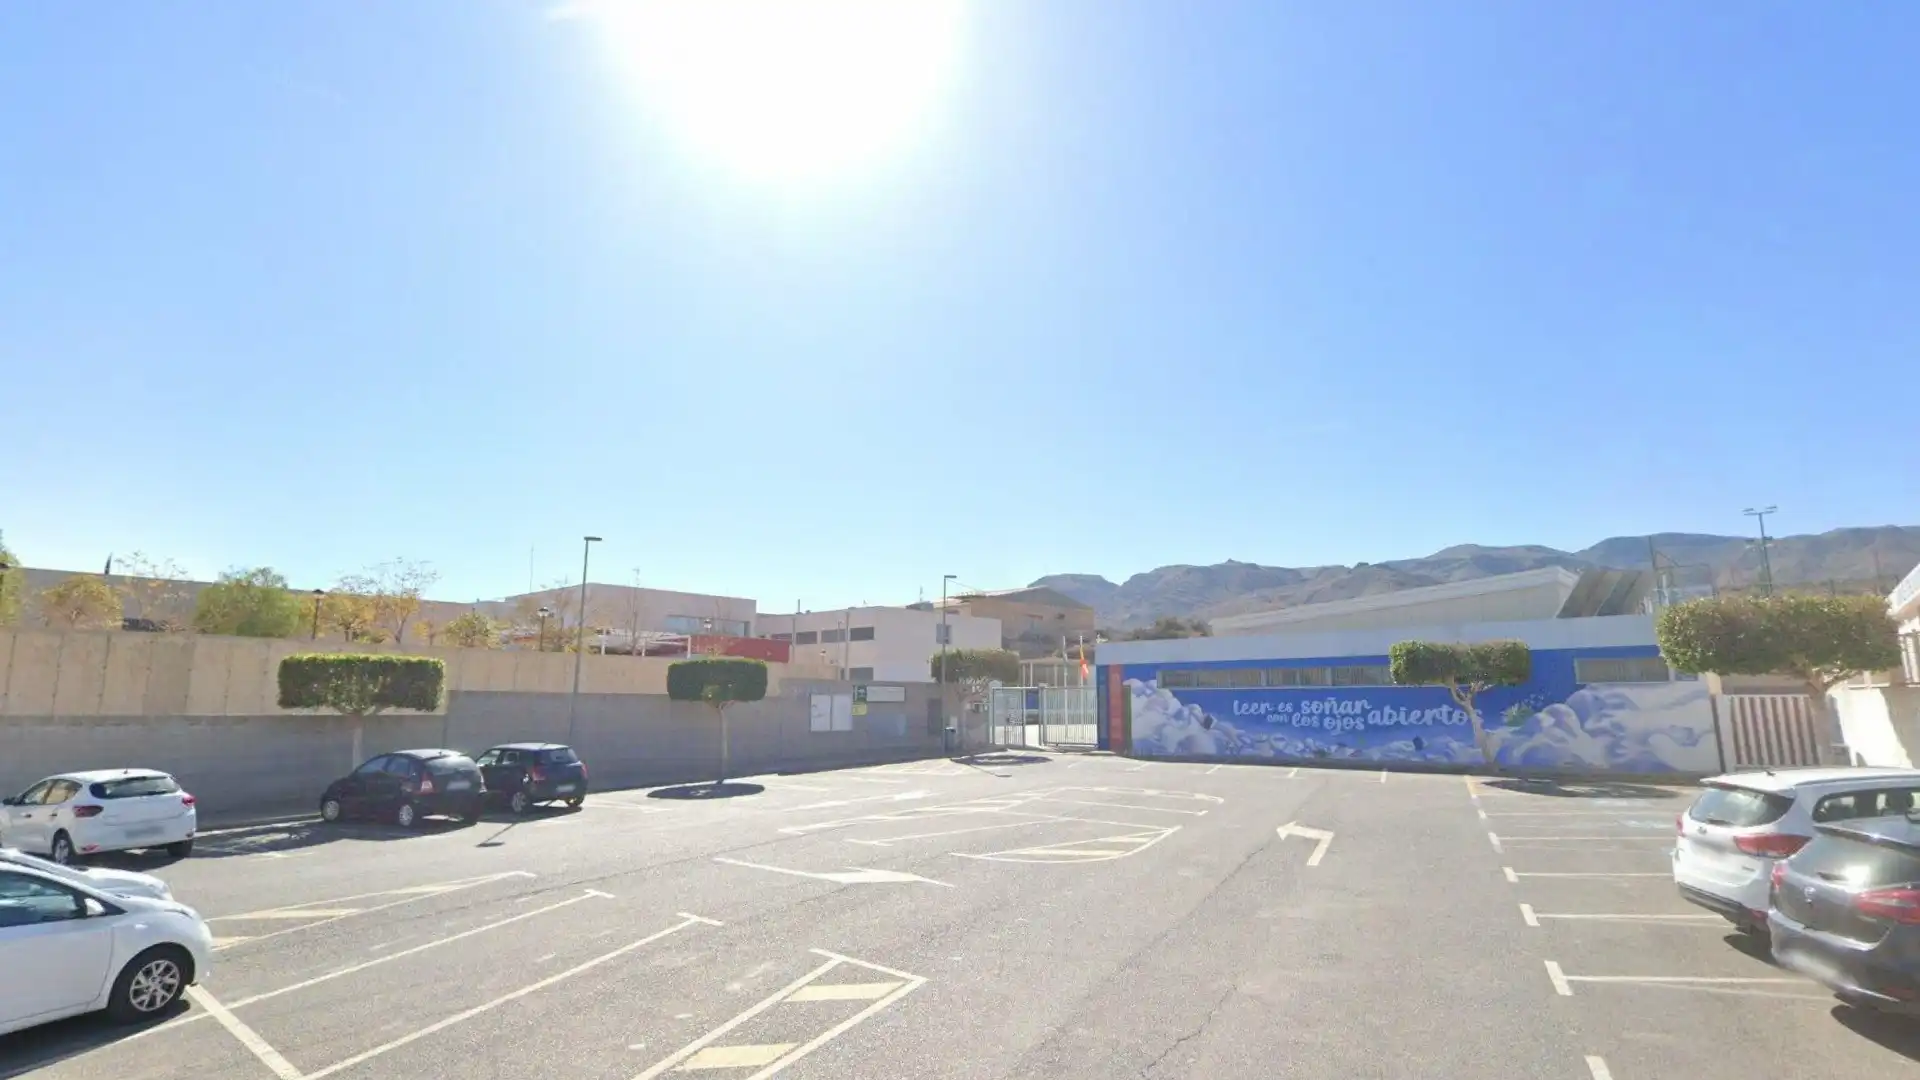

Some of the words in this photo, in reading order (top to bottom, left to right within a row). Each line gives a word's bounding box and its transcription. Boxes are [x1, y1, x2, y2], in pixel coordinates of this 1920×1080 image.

[1278, 701, 1293, 713] es
[1301, 697, 1372, 714] soñar
[1267, 714, 1289, 722] con
[1292, 712, 1320, 727] los
[1323, 715, 1365, 735] ojos
